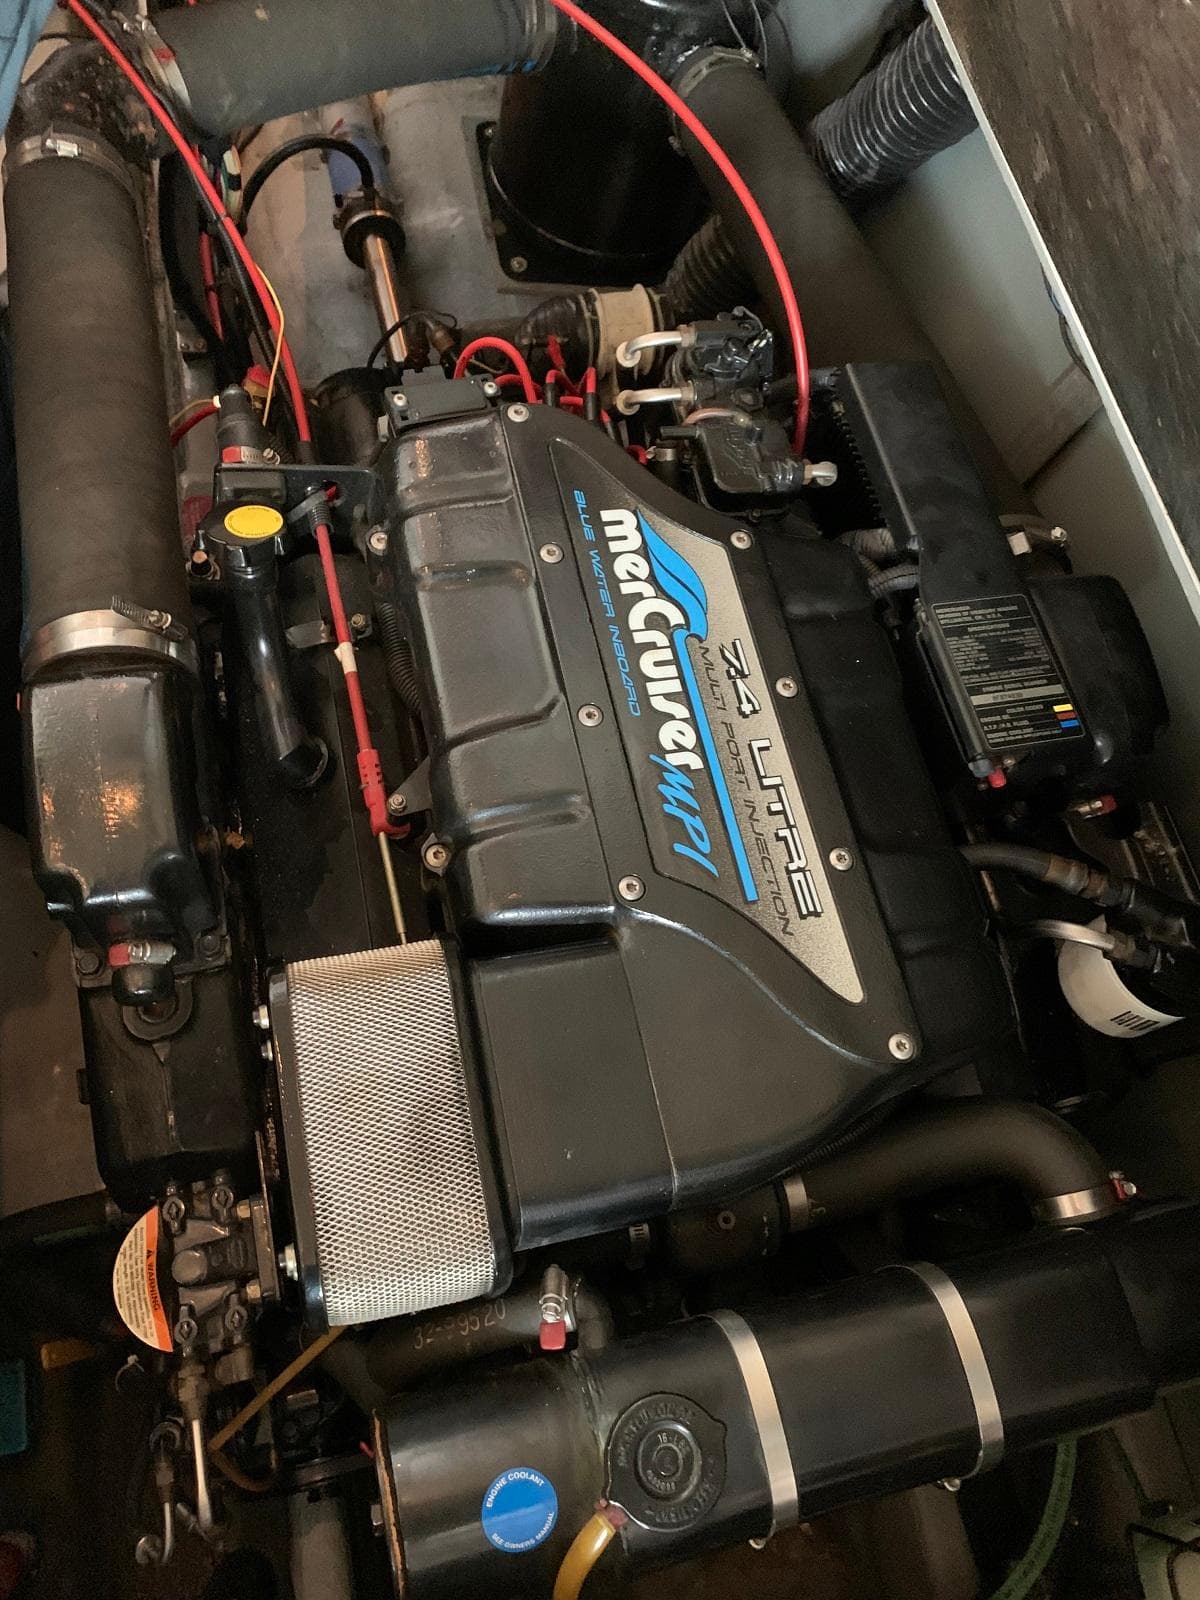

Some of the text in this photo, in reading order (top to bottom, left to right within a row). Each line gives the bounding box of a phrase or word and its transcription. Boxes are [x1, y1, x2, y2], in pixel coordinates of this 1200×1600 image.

[573, 489, 641, 717] BLUE WATER INBOARD
[649, 752, 720, 878] MPI
[698, 645, 794, 938] MULTI PORT INJECTION
[718, 638, 824, 920] 7.4 LITRE
[147, 1262, 161, 1311] WARNING
[486, 1471, 546, 1508] ENGINE COOLANT
[491, 1532, 505, 1546] SEE
[535, 1511, 555, 1541] MANUAL
